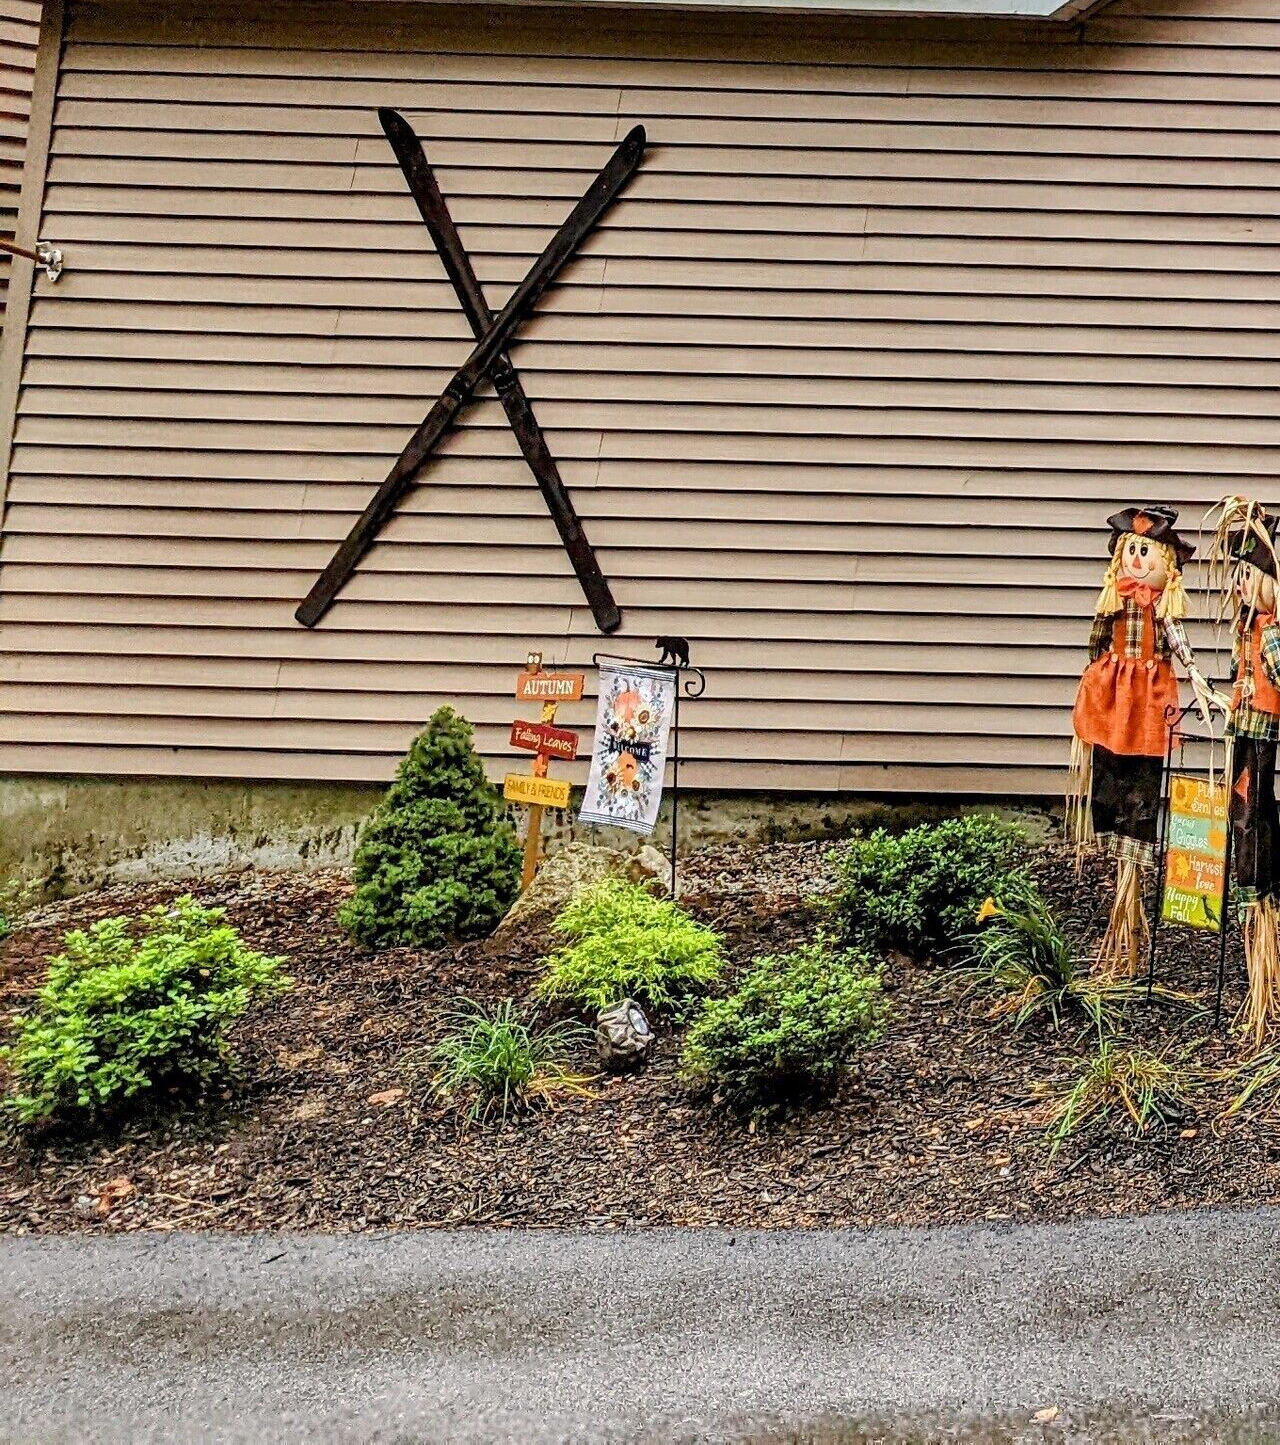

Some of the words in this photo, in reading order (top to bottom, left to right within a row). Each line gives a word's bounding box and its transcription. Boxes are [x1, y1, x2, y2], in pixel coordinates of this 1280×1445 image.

[523, 680, 575, 694] AUTUMN
[515, 727, 541, 749] Falling
[543, 734, 572, 752] Leaves
[507, 778, 530, 795] FAMILY
[1188, 854, 1223, 877] Harvest
[1165, 886, 1198, 912] Happy
[1170, 905, 1192, 923] Fall
